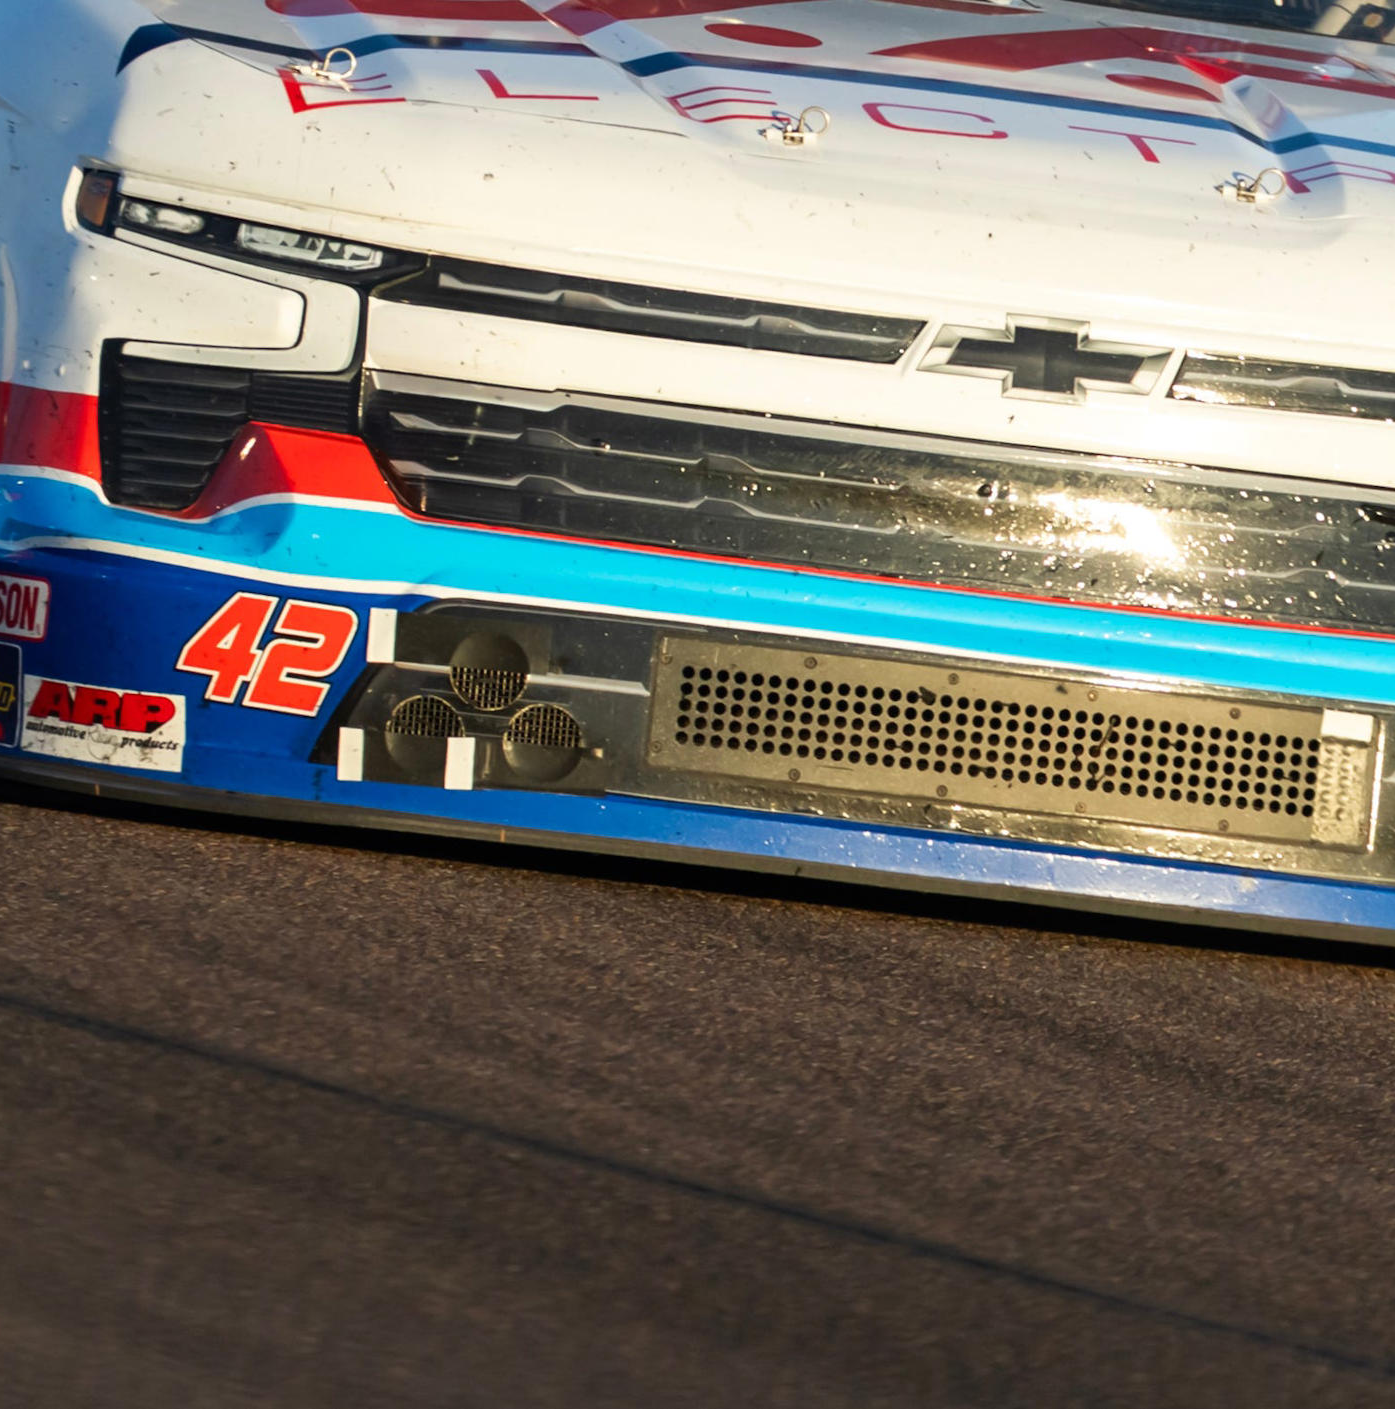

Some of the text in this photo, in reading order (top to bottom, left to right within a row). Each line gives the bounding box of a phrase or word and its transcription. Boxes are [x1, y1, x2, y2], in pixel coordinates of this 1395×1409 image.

[175, 591, 359, 717] 42
[28, 679, 176, 734] ARP
[25, 720, 179, 752] automotive products
